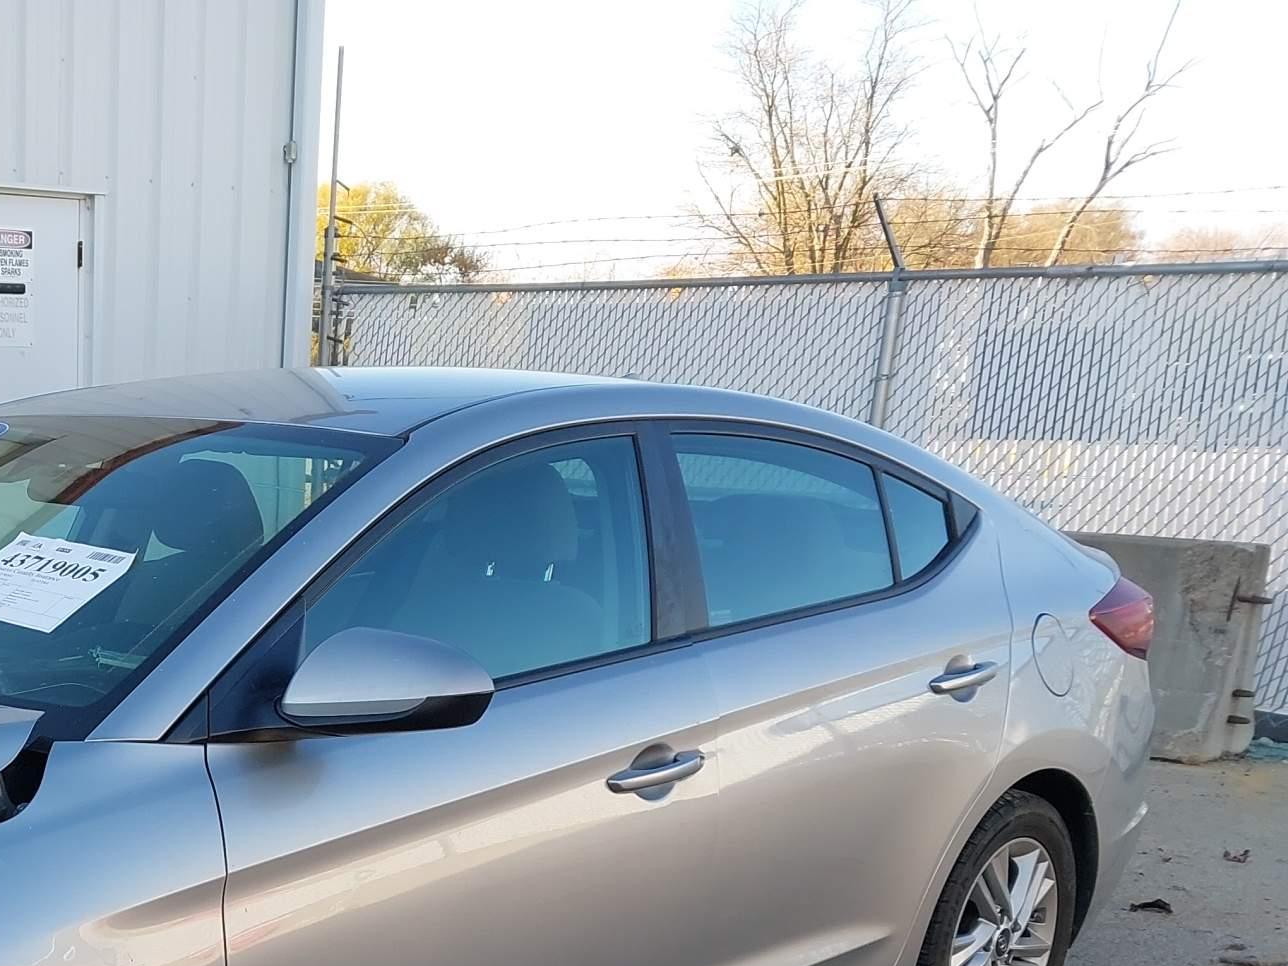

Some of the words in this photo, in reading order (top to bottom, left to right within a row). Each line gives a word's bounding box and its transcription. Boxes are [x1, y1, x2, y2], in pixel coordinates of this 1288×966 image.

[0, 249, 23, 258] SMOKING
[8, 258, 29, 268] FLAMES
[1, 267, 21, 276] SPARKS
[0, 551, 106, 583] 43719005
